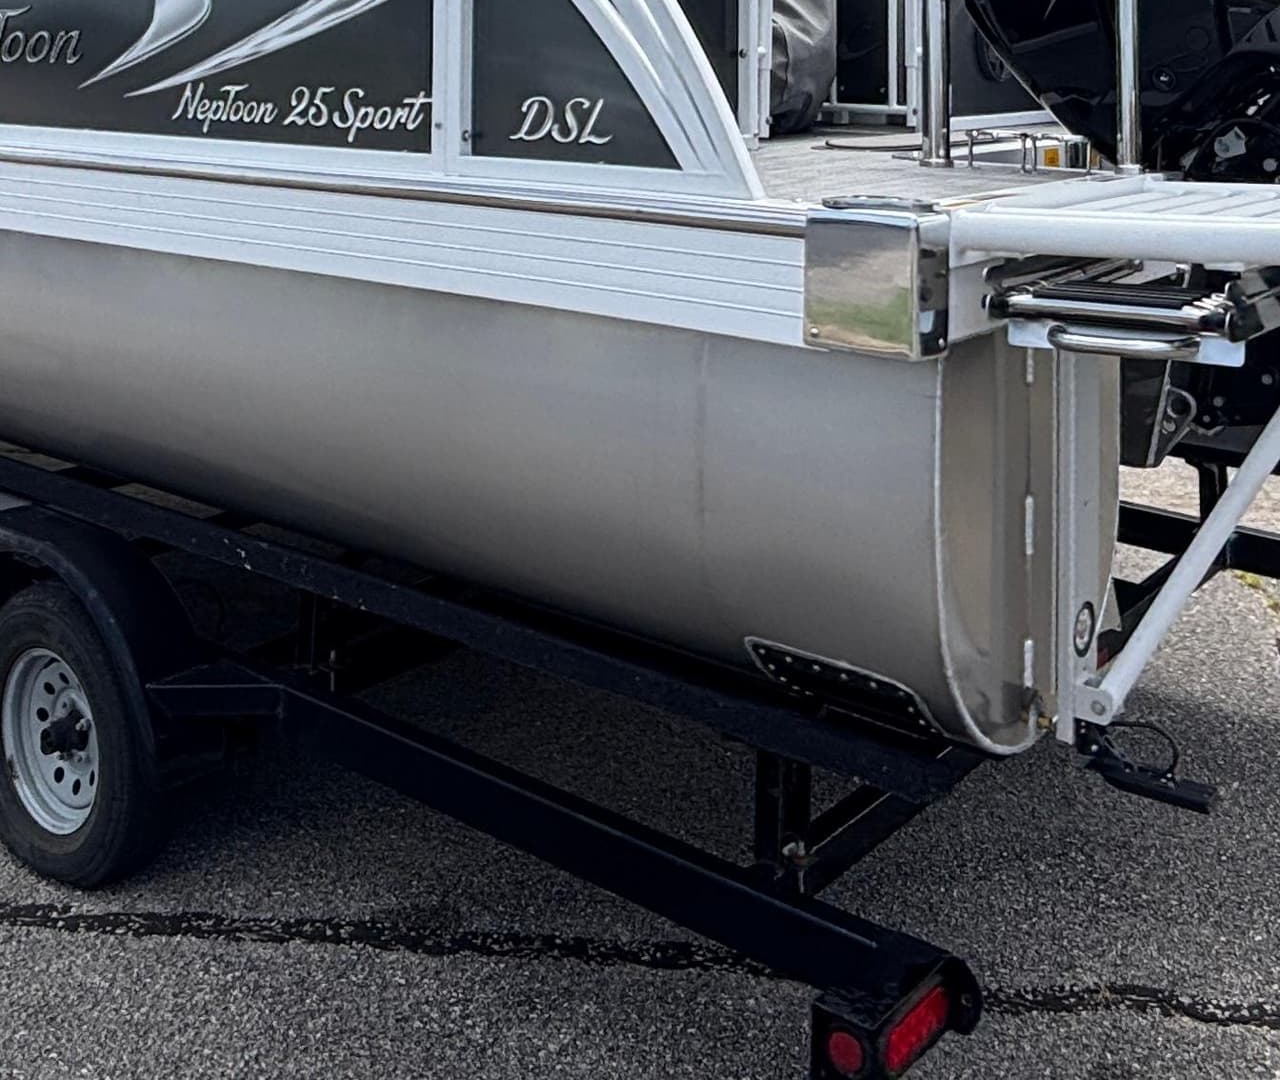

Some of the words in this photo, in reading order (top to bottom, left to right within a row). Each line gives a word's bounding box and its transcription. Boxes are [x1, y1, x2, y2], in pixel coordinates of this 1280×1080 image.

[172, 82, 277, 133] NepToon
[283, 86, 335, 127] 25
[333, 88, 433, 143] Sport
[509, 96, 613, 144] DSL
